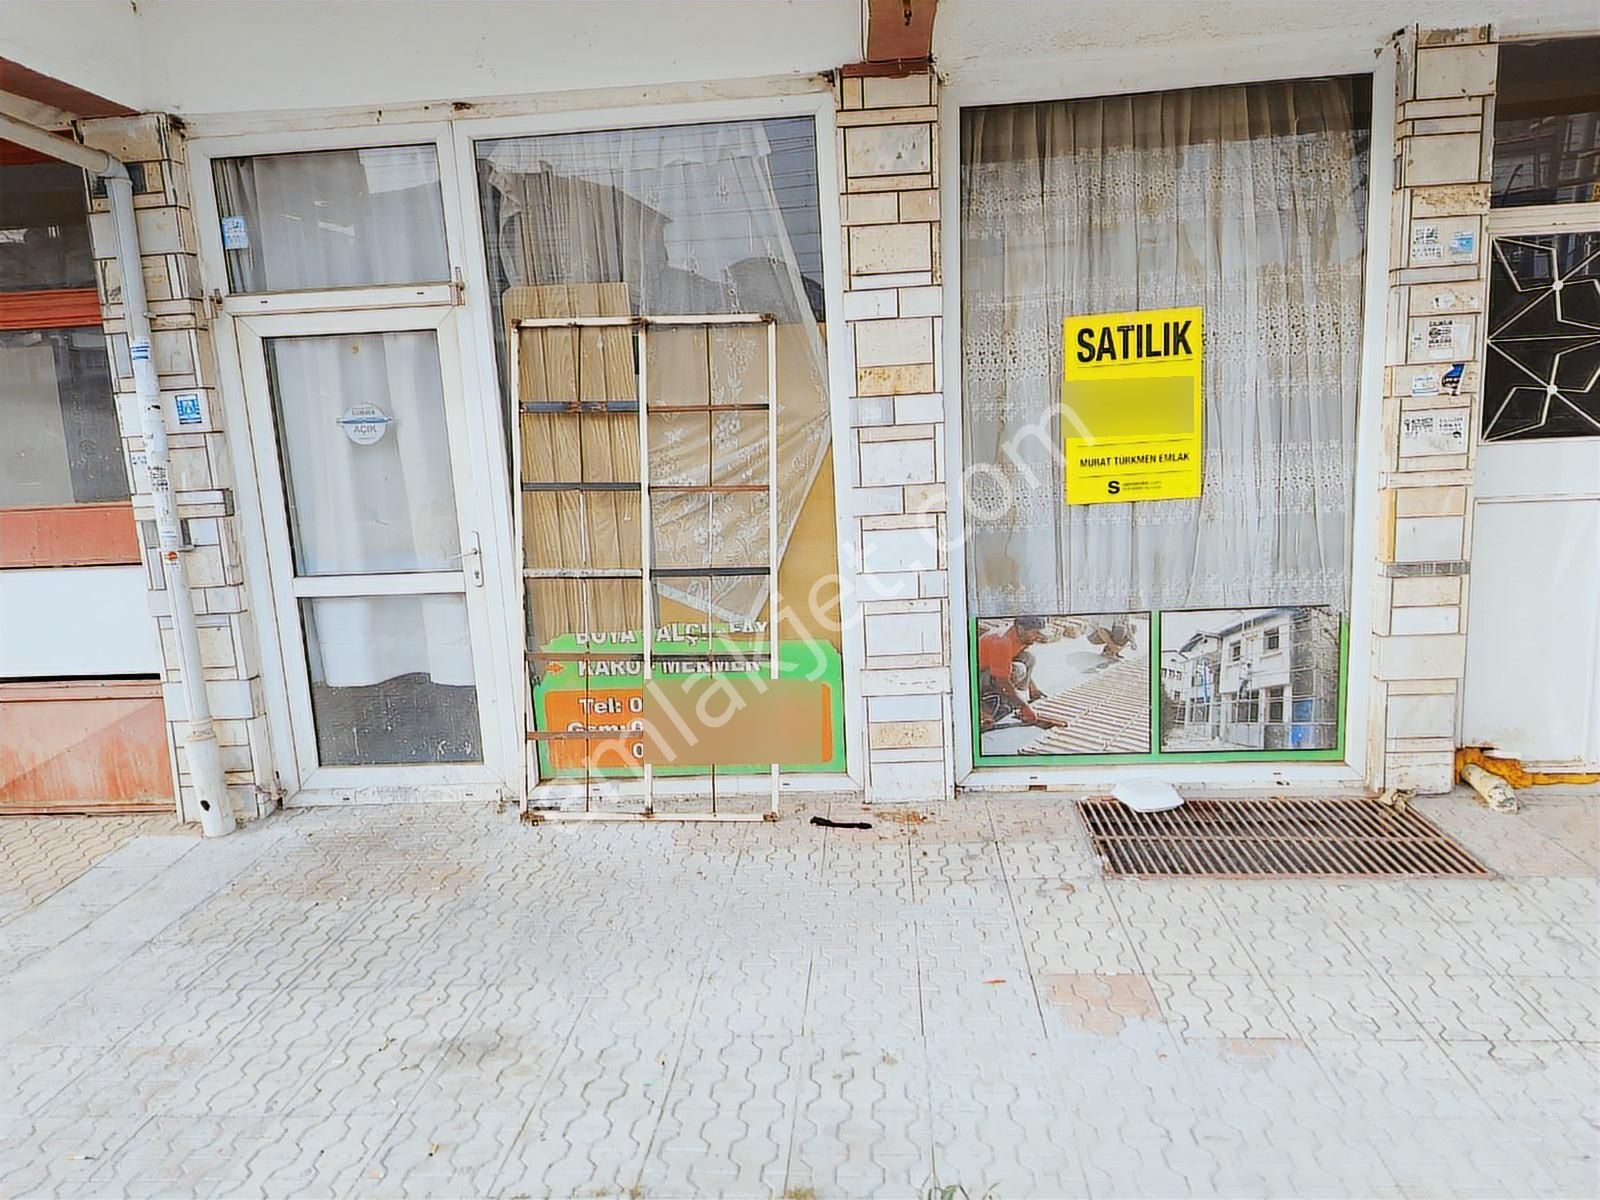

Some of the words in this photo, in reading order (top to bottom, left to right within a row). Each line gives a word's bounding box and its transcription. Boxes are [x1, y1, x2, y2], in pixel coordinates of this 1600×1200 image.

[1076, 319, 1193, 364] SATILIK
[1079, 457, 1112, 468] MURAT
[1159, 451, 1190, 463] EMLAK
[1107, 480, 1121, 495] S
[578, 696, 622, 715] Tel:
